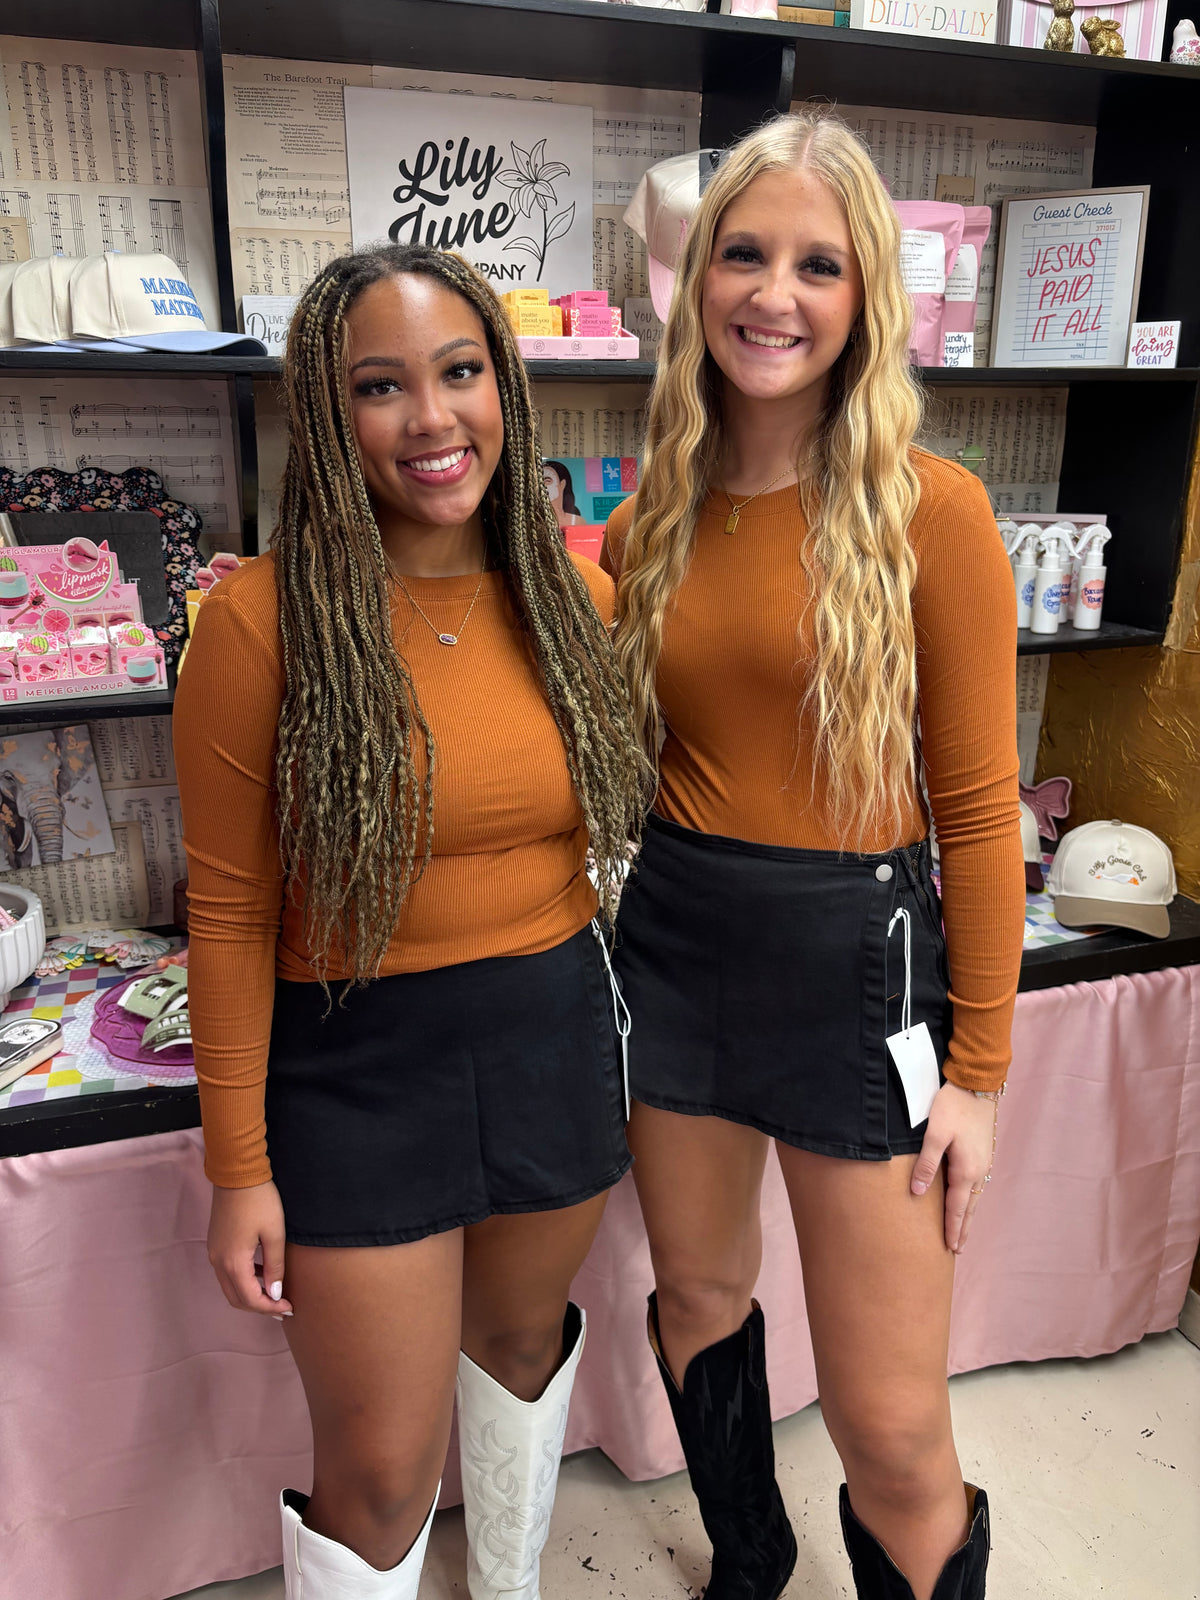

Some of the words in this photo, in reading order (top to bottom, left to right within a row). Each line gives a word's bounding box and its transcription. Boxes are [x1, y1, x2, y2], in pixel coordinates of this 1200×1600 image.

[869, 0, 993, 36] DILLY-DALLY
[264, 73, 281, 82] The
[285, 74, 322, 84] Barefoot
[393, 136, 503, 206] Lily
[1033, 205, 1070, 221] Guest
[1074, 202, 1113, 218] Check
[388, 202, 516, 249] June
[1027, 238, 1101, 278] JESUS
[474, 262, 526, 280] PANY
[1039, 273, 1093, 310] PAID
[269, 316, 283, 324] LIVE
[634, 311, 652, 323] YOU
[1032, 313, 1057, 343] IT
[1063, 304, 1103, 337] ALL
[247, 313, 289, 343] Drea
[1137, 326, 1155, 338] YOU
[1158, 325, 1175, 337] ARE
[945, 334, 967, 345] undry
[1131, 337, 1175, 357] doing
[945, 344, 972, 359] tergent
[1136, 355, 1163, 365] GREAT
